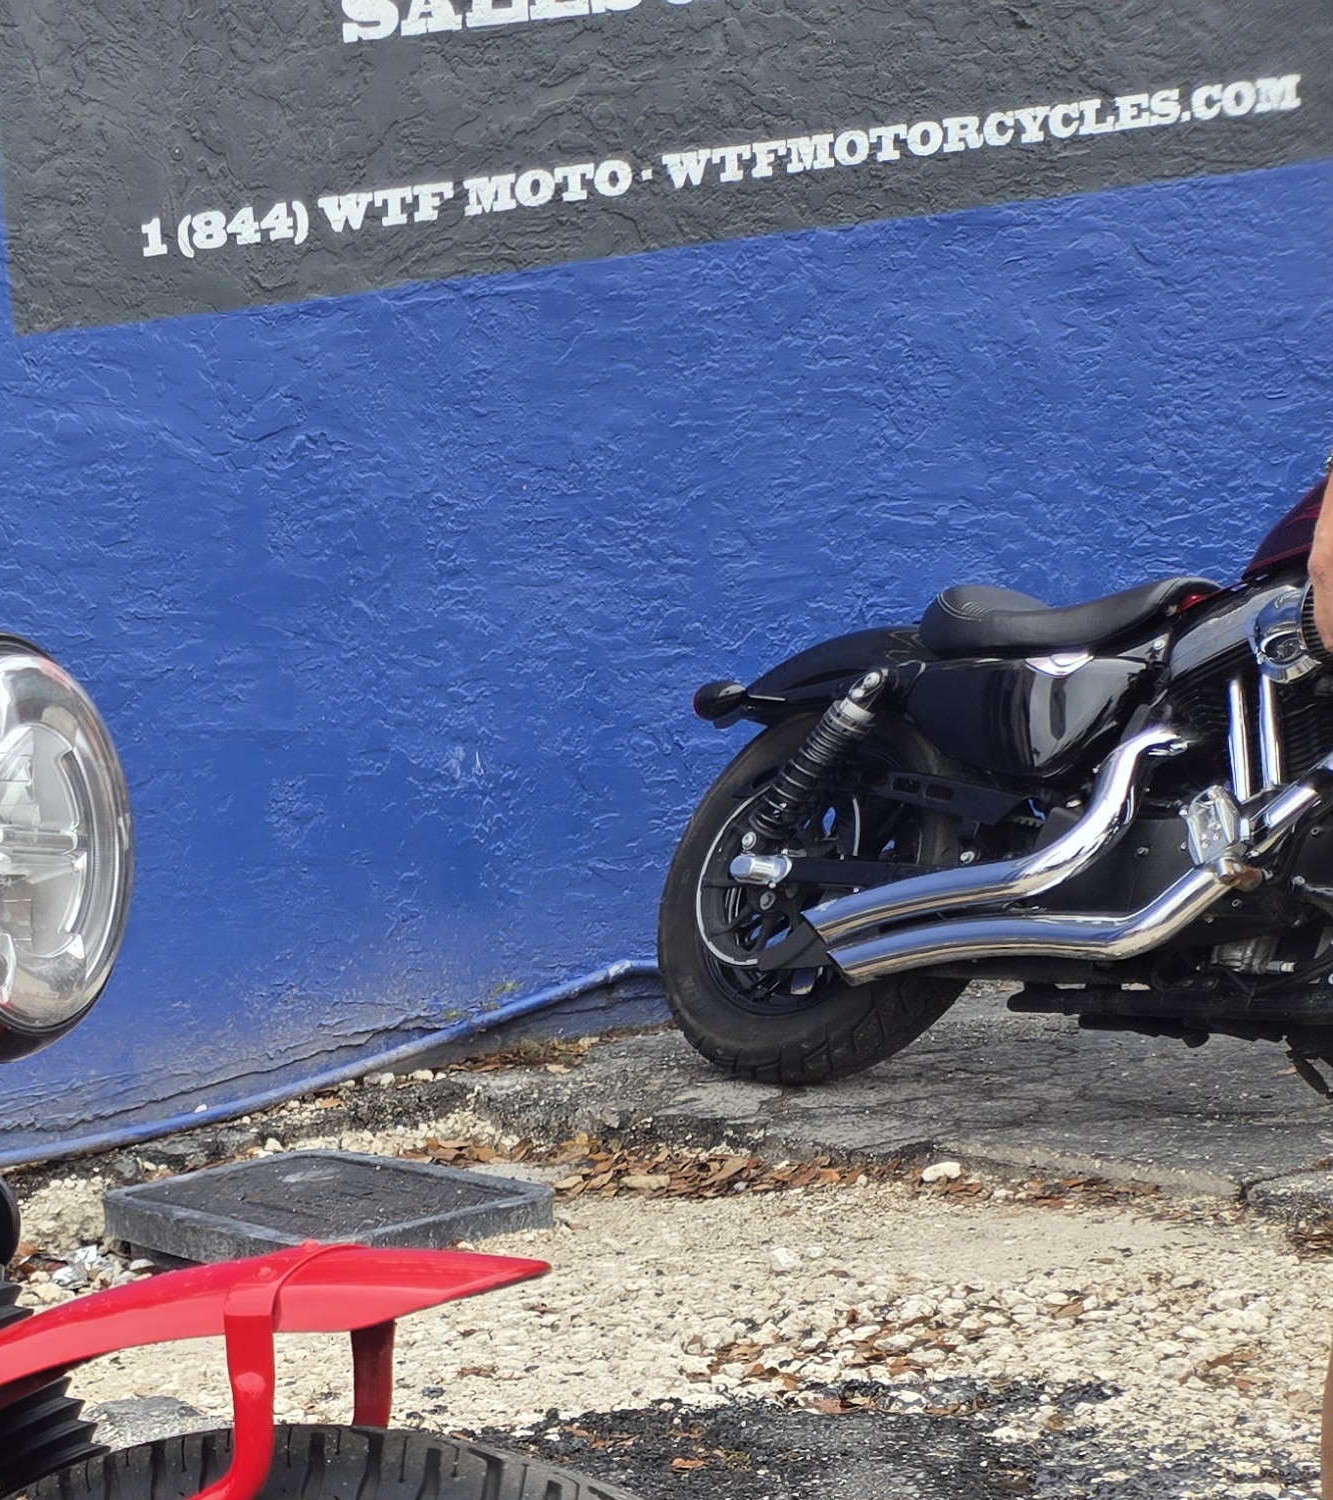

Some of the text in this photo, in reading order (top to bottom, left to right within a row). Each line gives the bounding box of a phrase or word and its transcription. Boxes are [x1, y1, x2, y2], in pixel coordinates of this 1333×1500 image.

[142, 74, 1302, 258] 1 (844) WTF MOTO WTFMOTORCYCLES.COM
